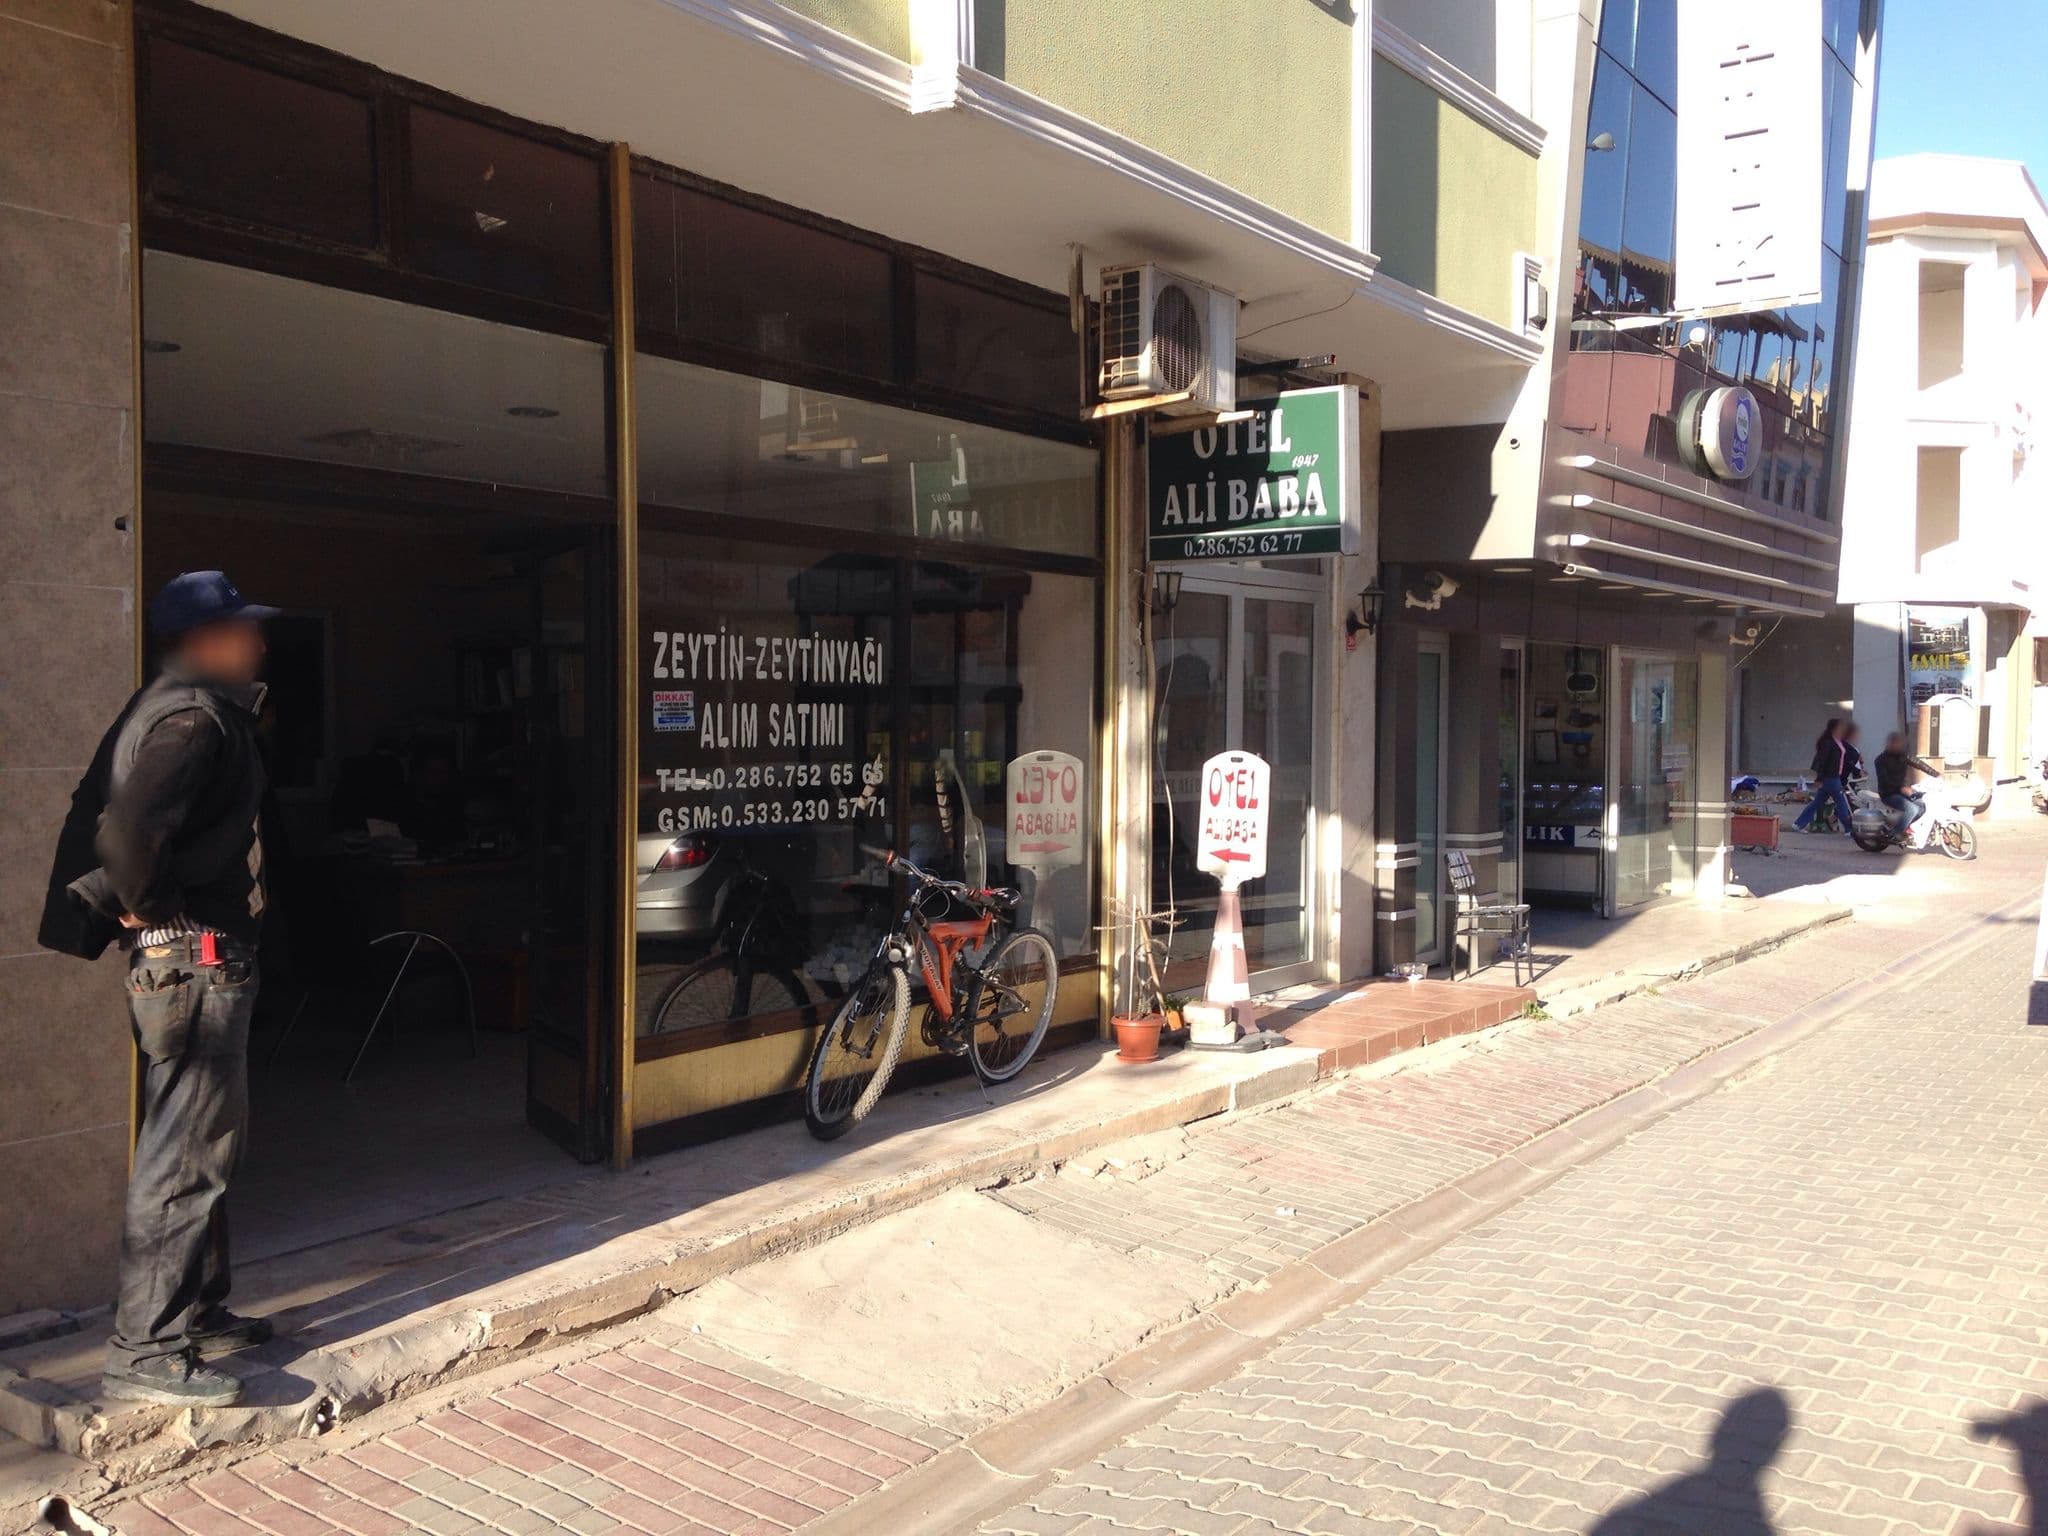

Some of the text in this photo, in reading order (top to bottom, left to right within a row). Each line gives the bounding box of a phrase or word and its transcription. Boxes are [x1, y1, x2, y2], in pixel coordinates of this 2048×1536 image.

[1193, 409, 1291, 458] OTEL
[1292, 454, 1319, 468] 1947
[1162, 472, 1327, 526] ALİ BABA
[1184, 534, 1303, 557] 0.286.752 62 77
[653, 626, 883, 685] ZEYTİN-ZEYTİNYAĞI
[701, 703, 844, 750] ALIM SATIMI
[830, 764, 853, 785] 65
[862, 763, 884, 785] 65
[1209, 767, 1258, 809] OTEL
[838, 798, 858, 819] 57
[868, 797, 886, 817] 71
